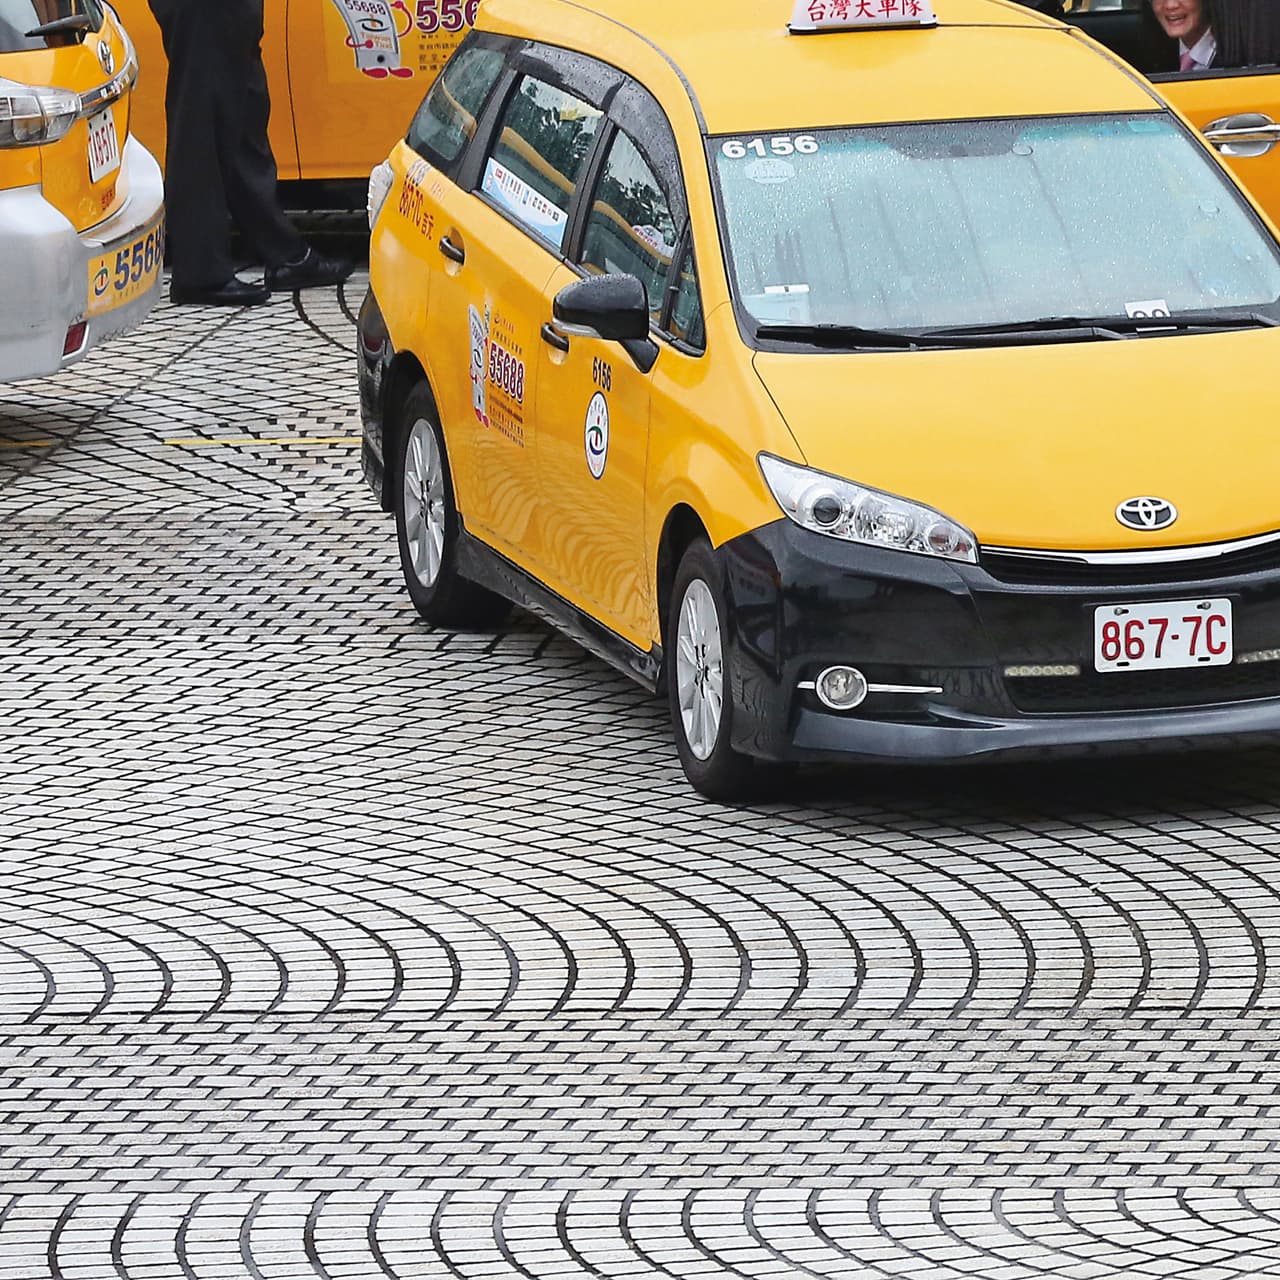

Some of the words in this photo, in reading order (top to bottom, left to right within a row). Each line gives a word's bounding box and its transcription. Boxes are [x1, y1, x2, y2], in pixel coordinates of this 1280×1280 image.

[721, 135, 819, 159] 6156
[114, 231, 165, 291] 5568
[488, 341, 526, 405] 55688
[592, 356, 612, 392] 6156
[1100, 613, 1228, 662] 867-7C
